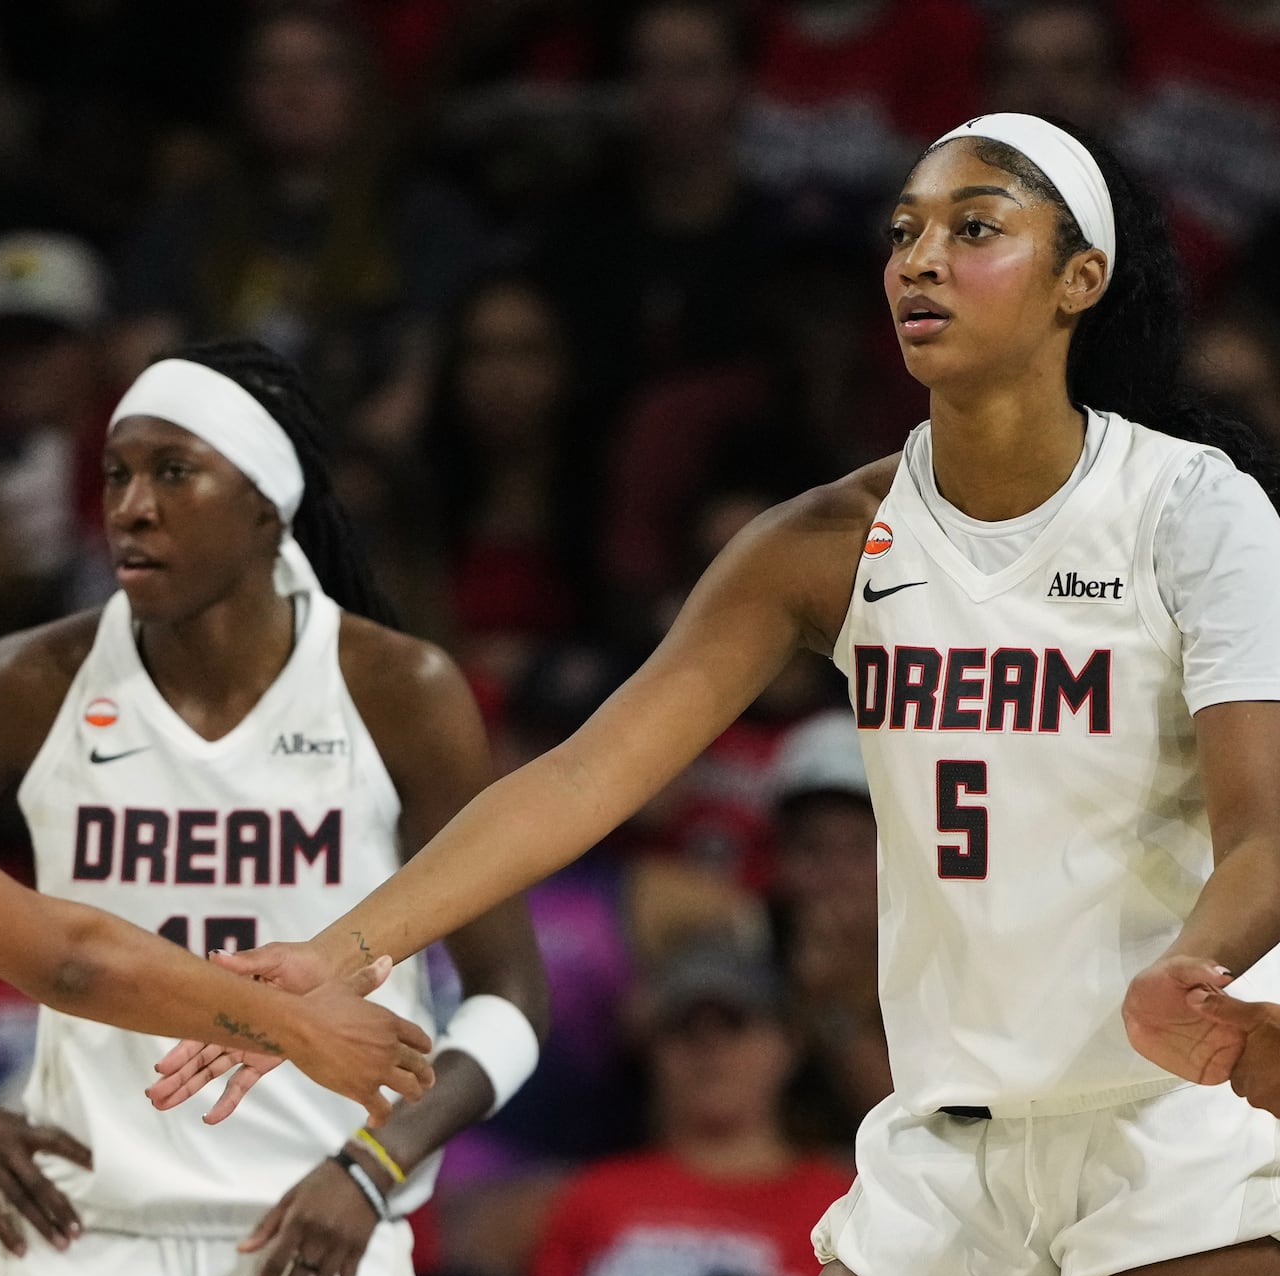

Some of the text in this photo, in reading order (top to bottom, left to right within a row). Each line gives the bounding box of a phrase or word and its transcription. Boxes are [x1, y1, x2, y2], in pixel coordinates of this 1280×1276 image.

[1047, 571, 1124, 600] Albert
[854, 645, 1112, 735] DREAM
[72, 806, 342, 886] DREAM
[936, 759, 988, 880] 5
